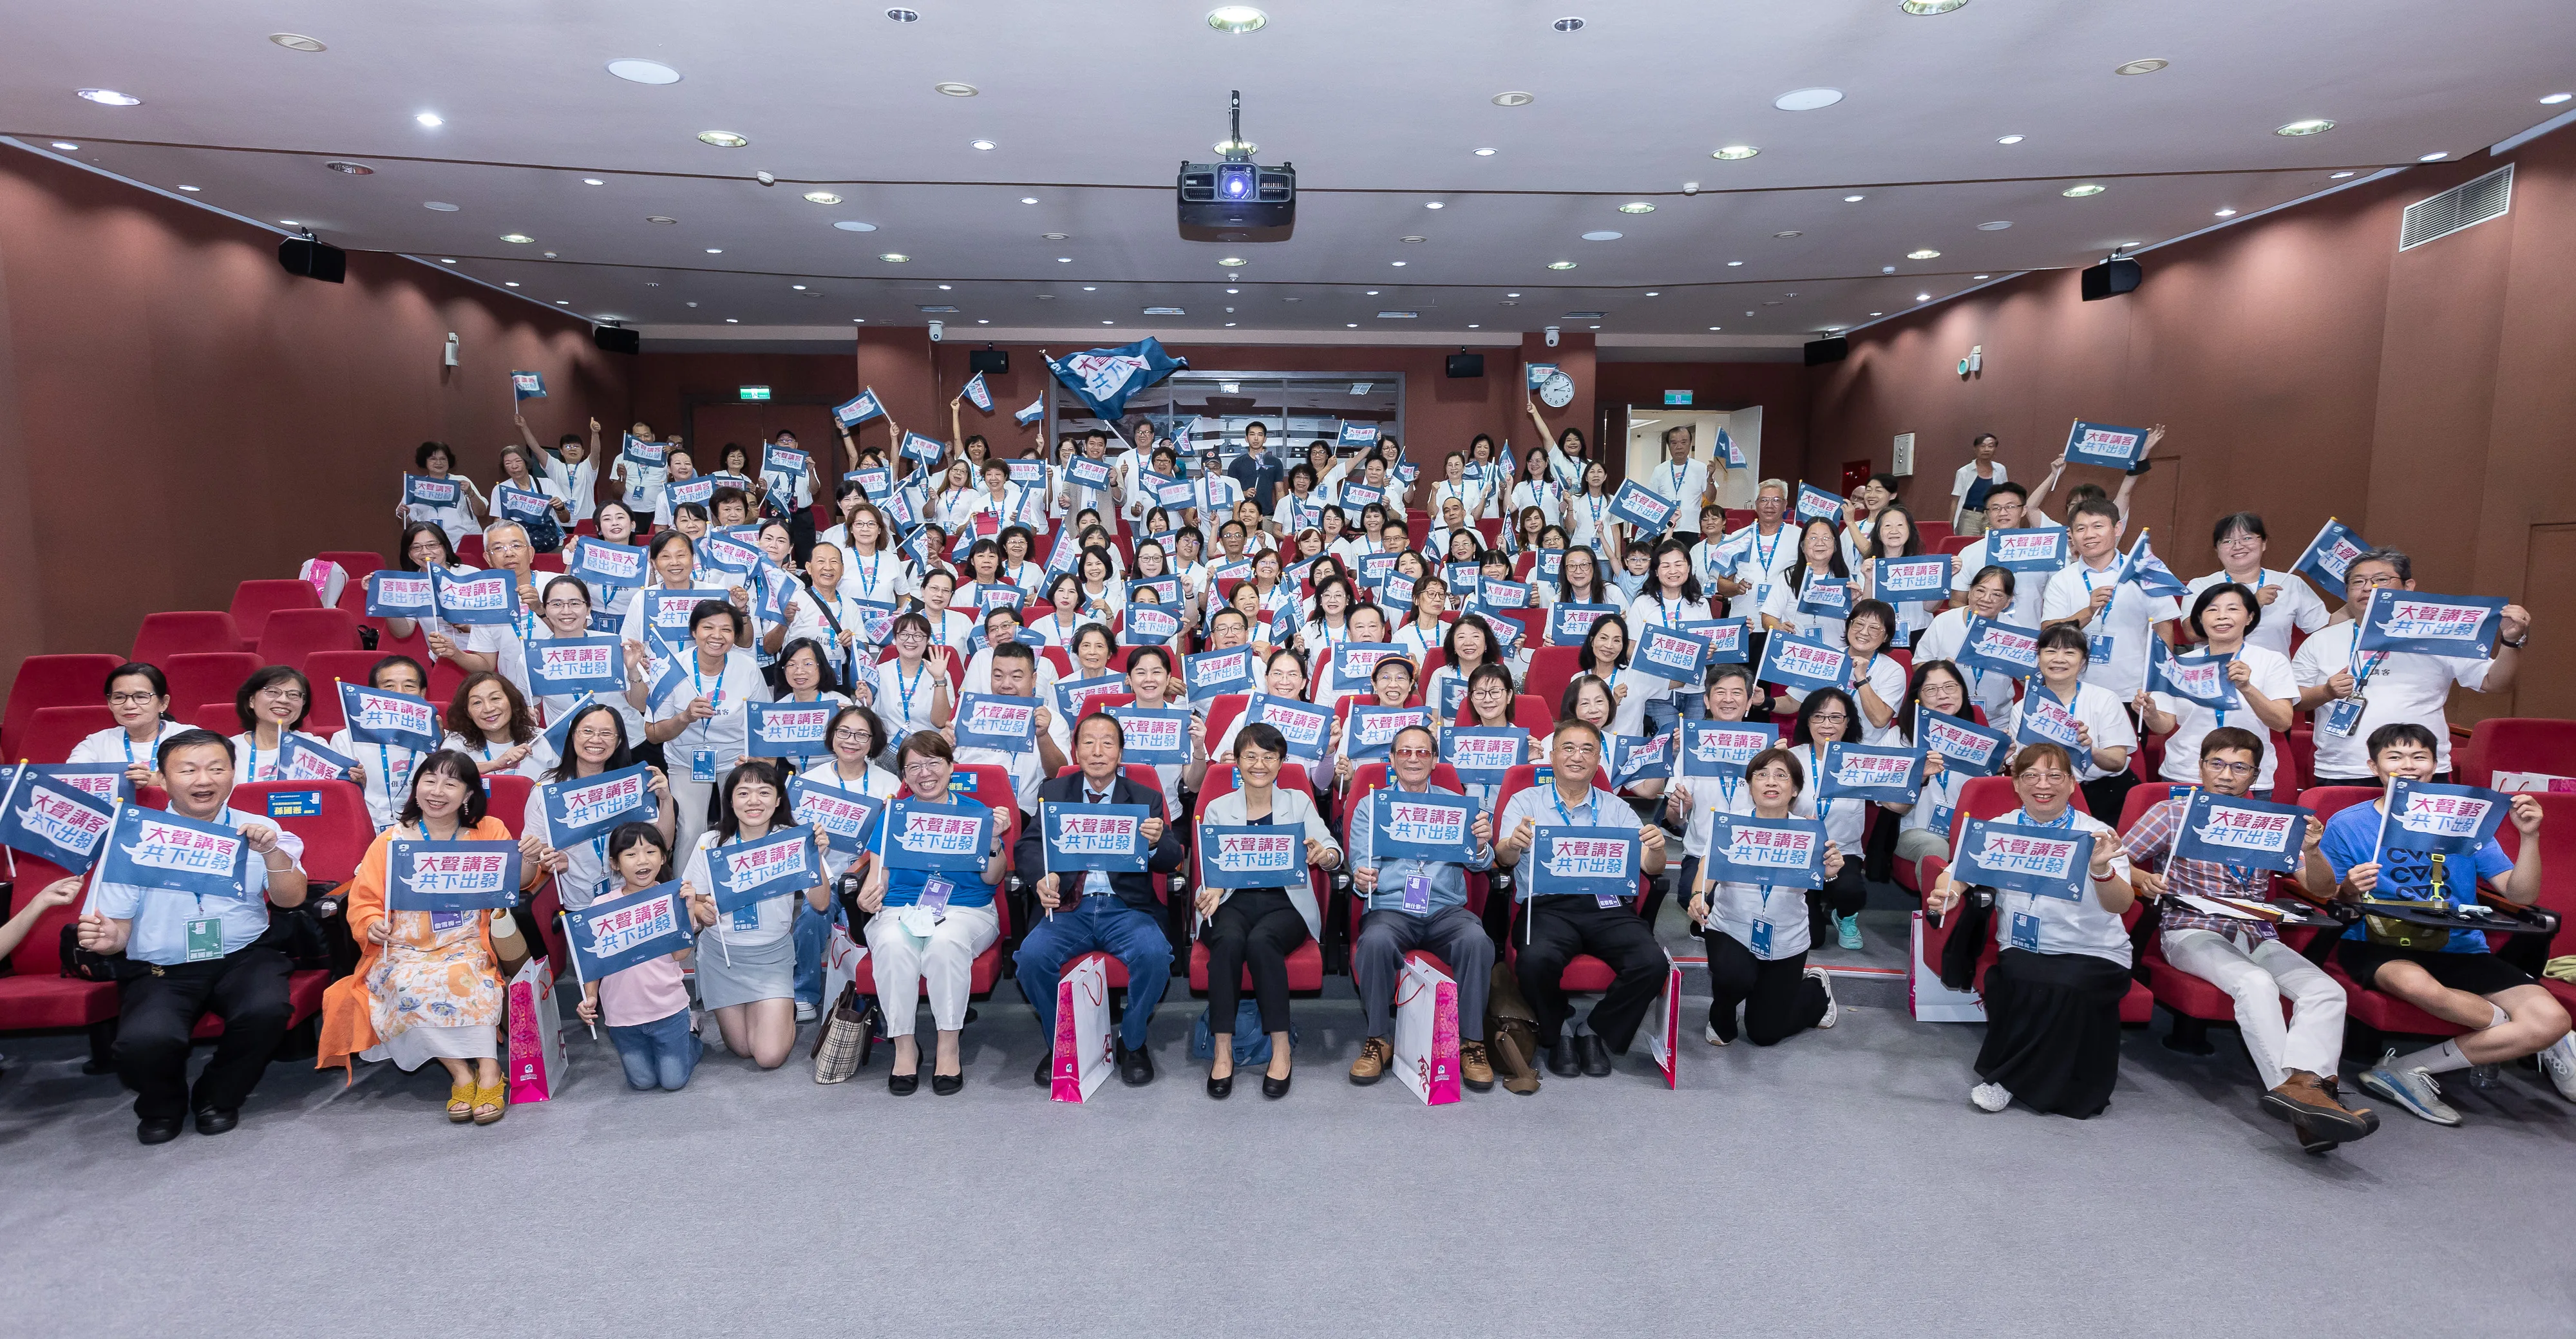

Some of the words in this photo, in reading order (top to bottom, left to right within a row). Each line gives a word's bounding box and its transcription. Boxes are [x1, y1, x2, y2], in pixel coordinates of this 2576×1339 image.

[2087, 432, 2134, 446] 大聲講客
[775, 451, 801, 461] 大聲講客
[2084, 442, 2129, 455] 共下出發
[1079, 462, 1106, 475] 大聲講客
[418, 483, 452, 492] 大聲講客
[418, 490, 451, 500] 共下出發
[677, 483, 709, 495] 大聲講客
[1351, 489, 1380, 499] 大聲講客
[510, 494, 546, 507] 大聲講客
[1633, 493, 1666, 513] 大聲講客
[1805, 495, 1837, 511] 大聲講客
[1627, 500, 1660, 520] 共下出發
[2004, 536, 2056, 547] 大聲講客
[2004, 546, 2051, 557] 共下出發
[2331, 542, 2358, 560] 大聲
[1368, 567, 1383, 576] 共下
[1891, 565, 1940, 576] 大聲講客
[443, 582, 502, 596] 大聲講客
[1891, 576, 1938, 587] 共下出發
[1391, 587, 1412, 600] 共下出
[1487, 585, 1522, 598] 大聲講客
[444, 594, 502, 608] 共下出發
[662, 613, 687, 623] 共下
[1139, 613, 1175, 625] 大聲講客
[2398, 605, 2483, 622] 大聲講客
[1137, 623, 1174, 634] 共下出發
[1482, 616, 1515, 636] 聲講客
[1567, 623, 1591, 632] 共下
[2392, 620, 2474, 636] 共下出發
[1656, 637, 1698, 655] 大聲講客
[1712, 638, 1734, 648] 出發
[547, 649, 607, 663] 大聲講客
[1351, 652, 1382, 663] 大聲講
[1651, 649, 1693, 666] 共下出發
[1785, 646, 1841, 665] 大聲講客
[1983, 643, 2036, 663] 共下出發
[549, 661, 607, 675] 共下出發
[1200, 655, 1242, 673] 大聲講客
[1350, 664, 1372, 674] 共下
[1781, 658, 1836, 677] 共下出發
[1202, 666, 1242, 683] 共下出發
[366, 697, 430, 720] 大聲講客
[976, 706, 1029, 720] 大聲講客
[2038, 703, 2080, 728] 大聲講
[366, 710, 428, 732] 共下出發
[768, 712, 825, 726] 大聲講客
[974, 719, 1026, 734] 共下出發
[1265, 708, 1321, 729] 大聲講客
[1366, 715, 1420, 730] 大聲講客
[768, 726, 824, 739] 共下出發
[1122, 720, 1178, 734] 大聲講客
[2035, 716, 2081, 742] 共下出
[1124, 734, 1175, 747] 共下出發
[1702, 734, 1763, 748] 大聲講客
[1931, 723, 1993, 751] 大聲講客
[1459, 740, 1515, 752] 大聲講客
[1931, 736, 1986, 761] 共下出發
[296, 752, 337, 780] 大聲講客
[1457, 753, 1512, 766] 共下出發
[1845, 756, 1911, 771] 大聲講客
[57, 775, 113, 793] 講客
[1843, 770, 1905, 784] 共下出發
[570, 777, 638, 810] 大聲講客
[33, 794, 108, 833] 大聲講客
[573, 793, 639, 825] 共下出發
[802, 795, 866, 821] 大聲講客
[1396, 807, 1463, 824] 大聲講客
[2412, 797, 2484, 818] 大聲講客
[798, 808, 859, 833] 共下出發
[910, 816, 977, 835] 大聲講客
[1065, 819, 1133, 834] 大聲講客
[2211, 810, 2288, 831] 大聲講客
[2411, 813, 2475, 833] 共下出發
[29, 812, 95, 849] 共下出發
[1395, 823, 1459, 840] 共下出發
[2208, 826, 2282, 848] 共下出發
[146, 827, 236, 856] 大聲講客
[908, 832, 974, 850] 共下出發
[1065, 835, 1130, 850] 共下出發
[1224, 837, 1290, 851] 大聲講客
[1736, 830, 1812, 849] 大聲講客
[1988, 837, 2071, 858] 大聲講客
[140, 844, 231, 871] 共下出發
[734, 841, 802, 873] 大聲講客
[1557, 842, 1625, 858] 大聲講客
[1735, 846, 1807, 865] 共下出發
[420, 856, 502, 872] 大聲講客
[1225, 851, 1289, 867] 共下出發
[1557, 857, 1622, 874] 共下出發
[1985, 852, 2064, 874] 共下出發
[737, 853, 801, 889] 共下出發
[419, 873, 499, 889] 共下出發
[597, 898, 669, 937] 大聲講客
[602, 916, 671, 953] 共下出發
